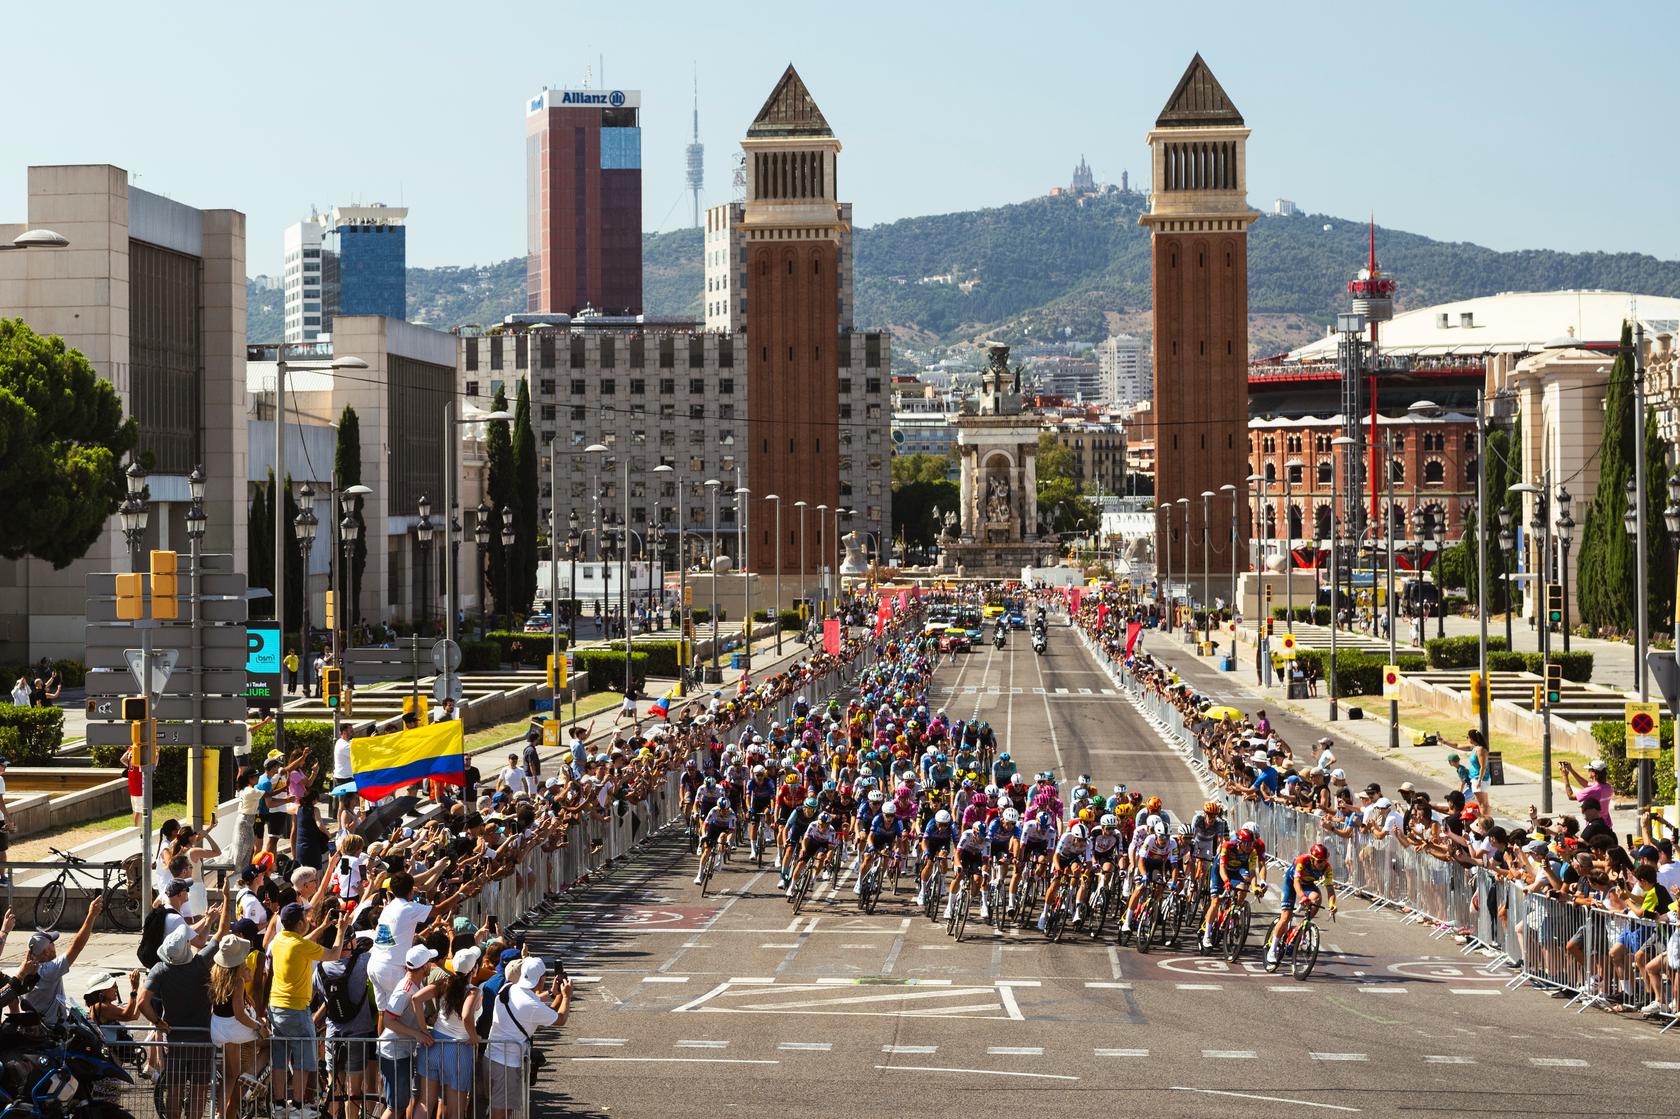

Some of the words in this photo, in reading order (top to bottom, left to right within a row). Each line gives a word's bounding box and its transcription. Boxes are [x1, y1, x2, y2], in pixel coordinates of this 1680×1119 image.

[562, 92, 607, 104] Allianz
[246, 633, 264, 662] P
[257, 654, 274, 662] bsm
